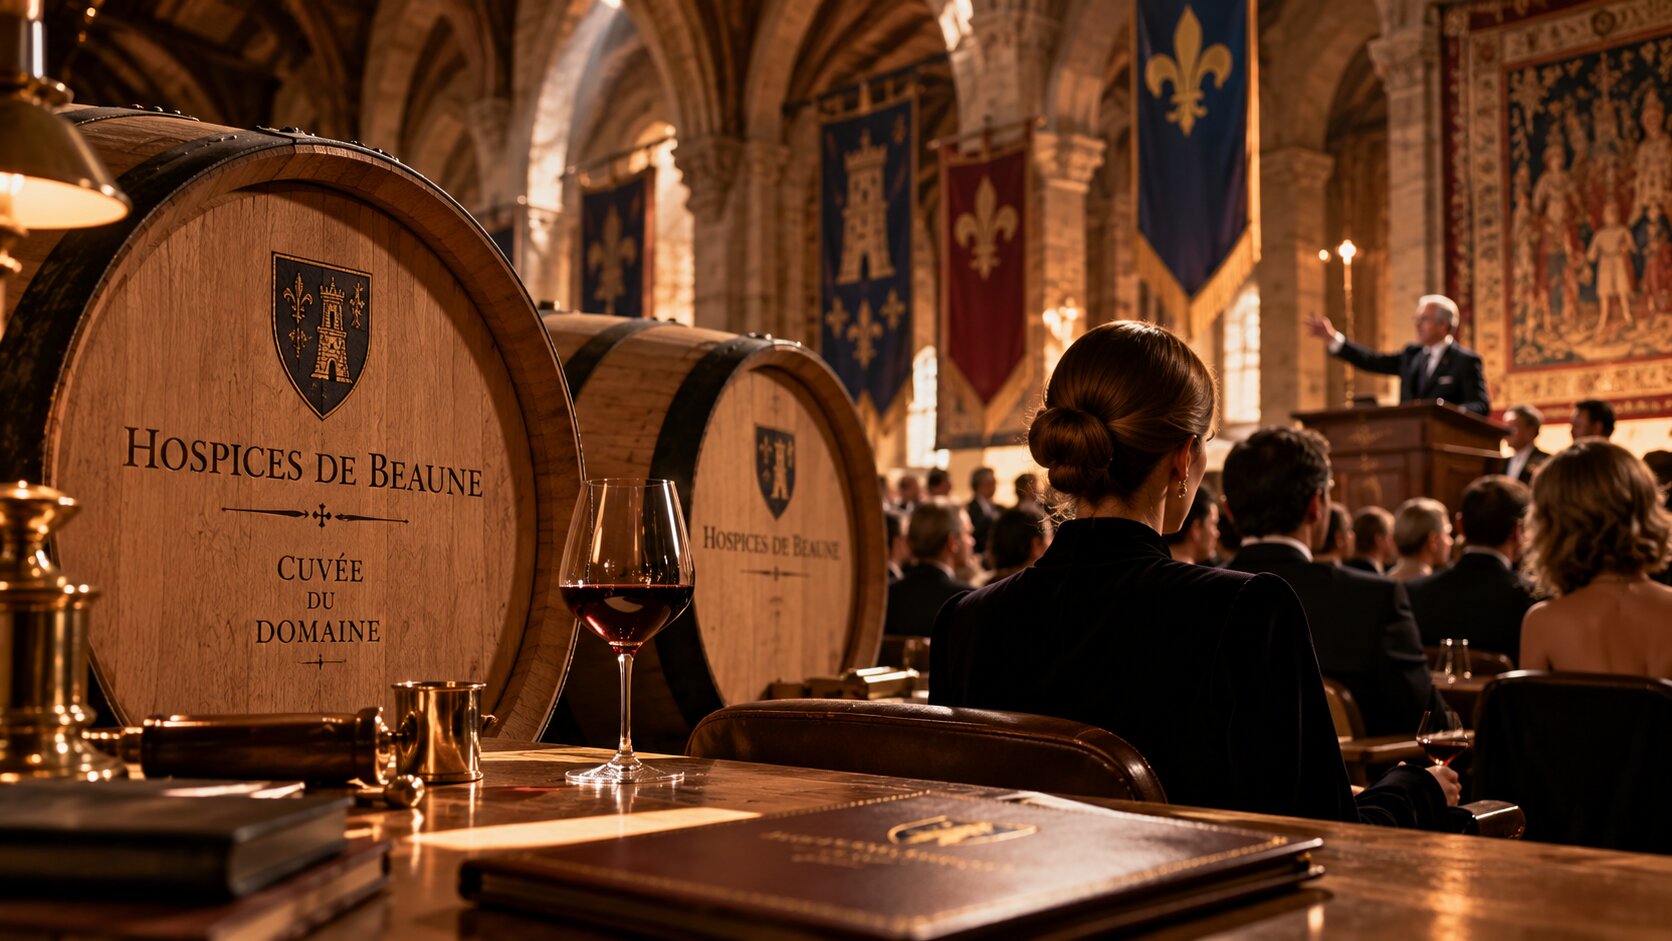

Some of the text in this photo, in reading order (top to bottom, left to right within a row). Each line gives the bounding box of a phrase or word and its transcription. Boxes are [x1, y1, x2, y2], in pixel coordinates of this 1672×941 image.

[123, 426, 484, 498] HOSPICES DE BEAUNE
[703, 525, 769, 553] HOSPICES
[772, 536, 790, 555] DE
[277, 552, 364, 583] CUVÉE
[307, 591, 335, 610] DU
[255, 619, 381, 644] DOMAINE
